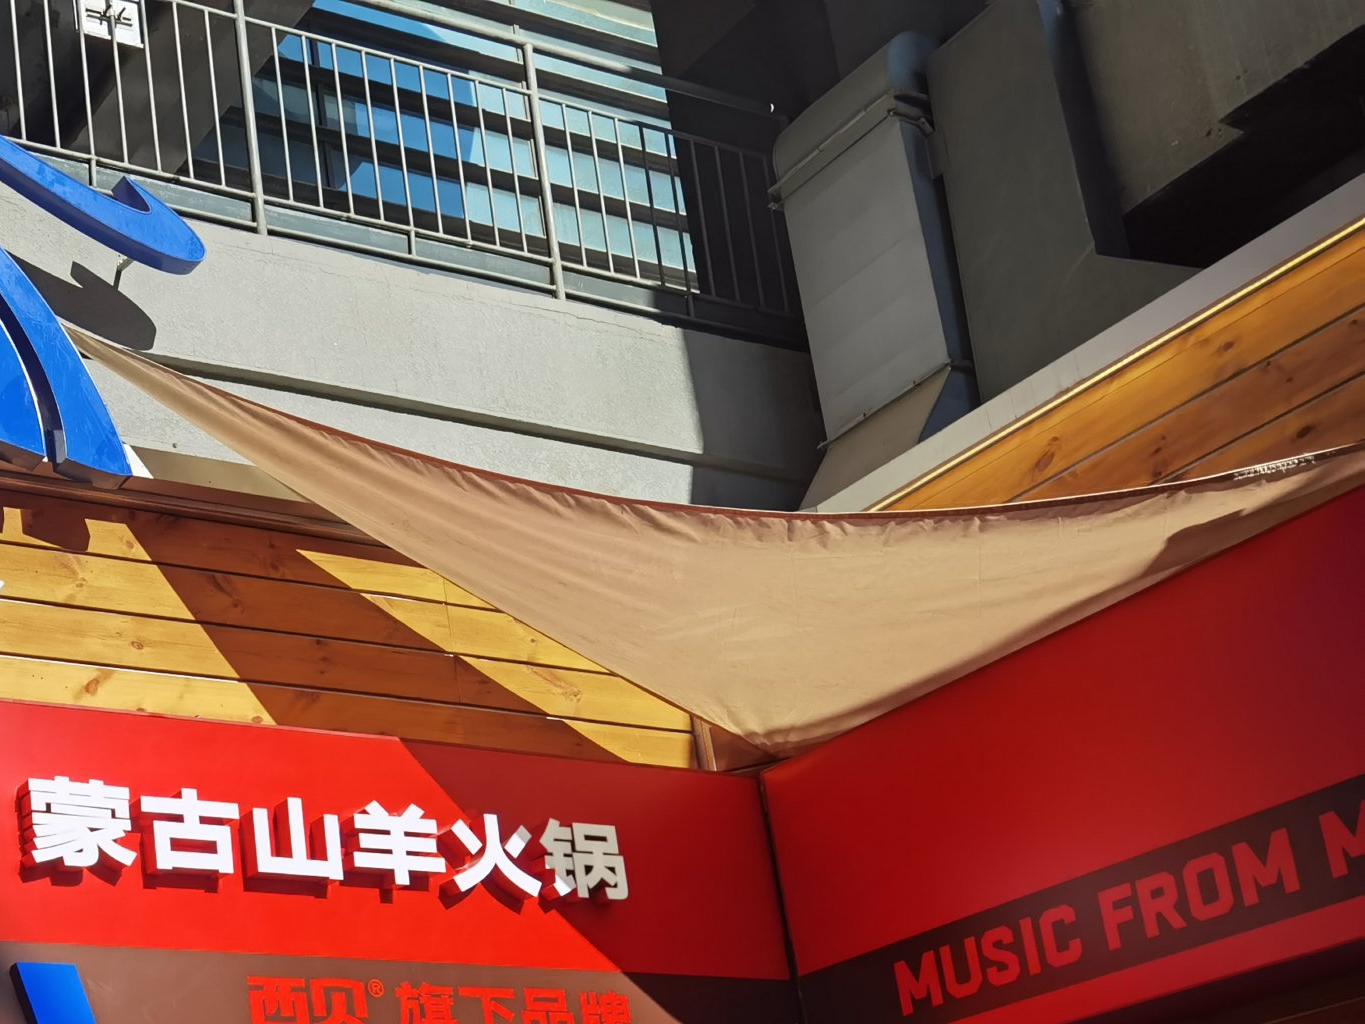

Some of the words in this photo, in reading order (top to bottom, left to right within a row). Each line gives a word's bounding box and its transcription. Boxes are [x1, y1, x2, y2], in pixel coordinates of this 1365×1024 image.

[26, 775, 629, 900] 蒙古山羊火锅
[894, 904, 1083, 1017] MUSIC
[1098, 827, 1301, 951] FROM
